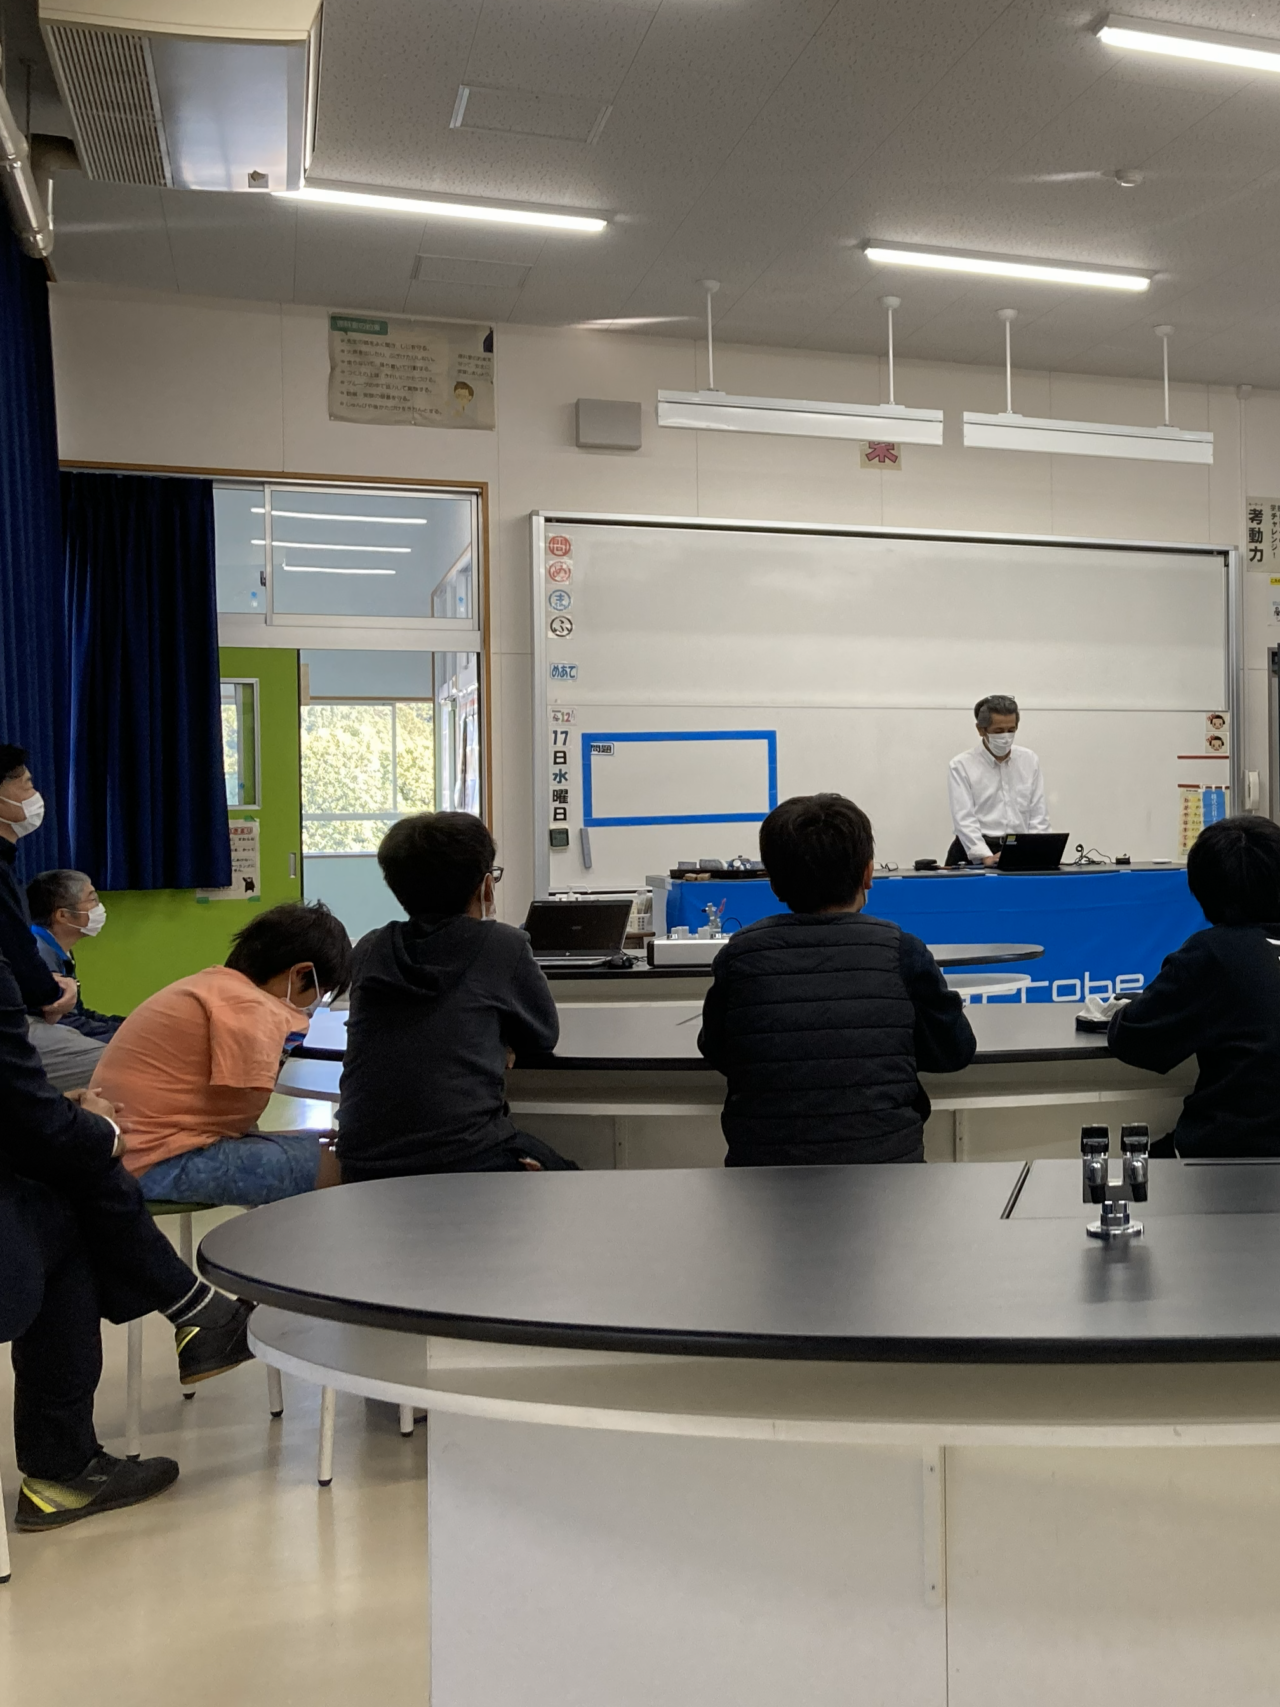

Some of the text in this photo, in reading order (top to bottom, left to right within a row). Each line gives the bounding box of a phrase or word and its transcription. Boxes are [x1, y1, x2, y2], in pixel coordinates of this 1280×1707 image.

[1248, 508, 1264, 562] 考動力
[551, 665, 576, 678] めあて
